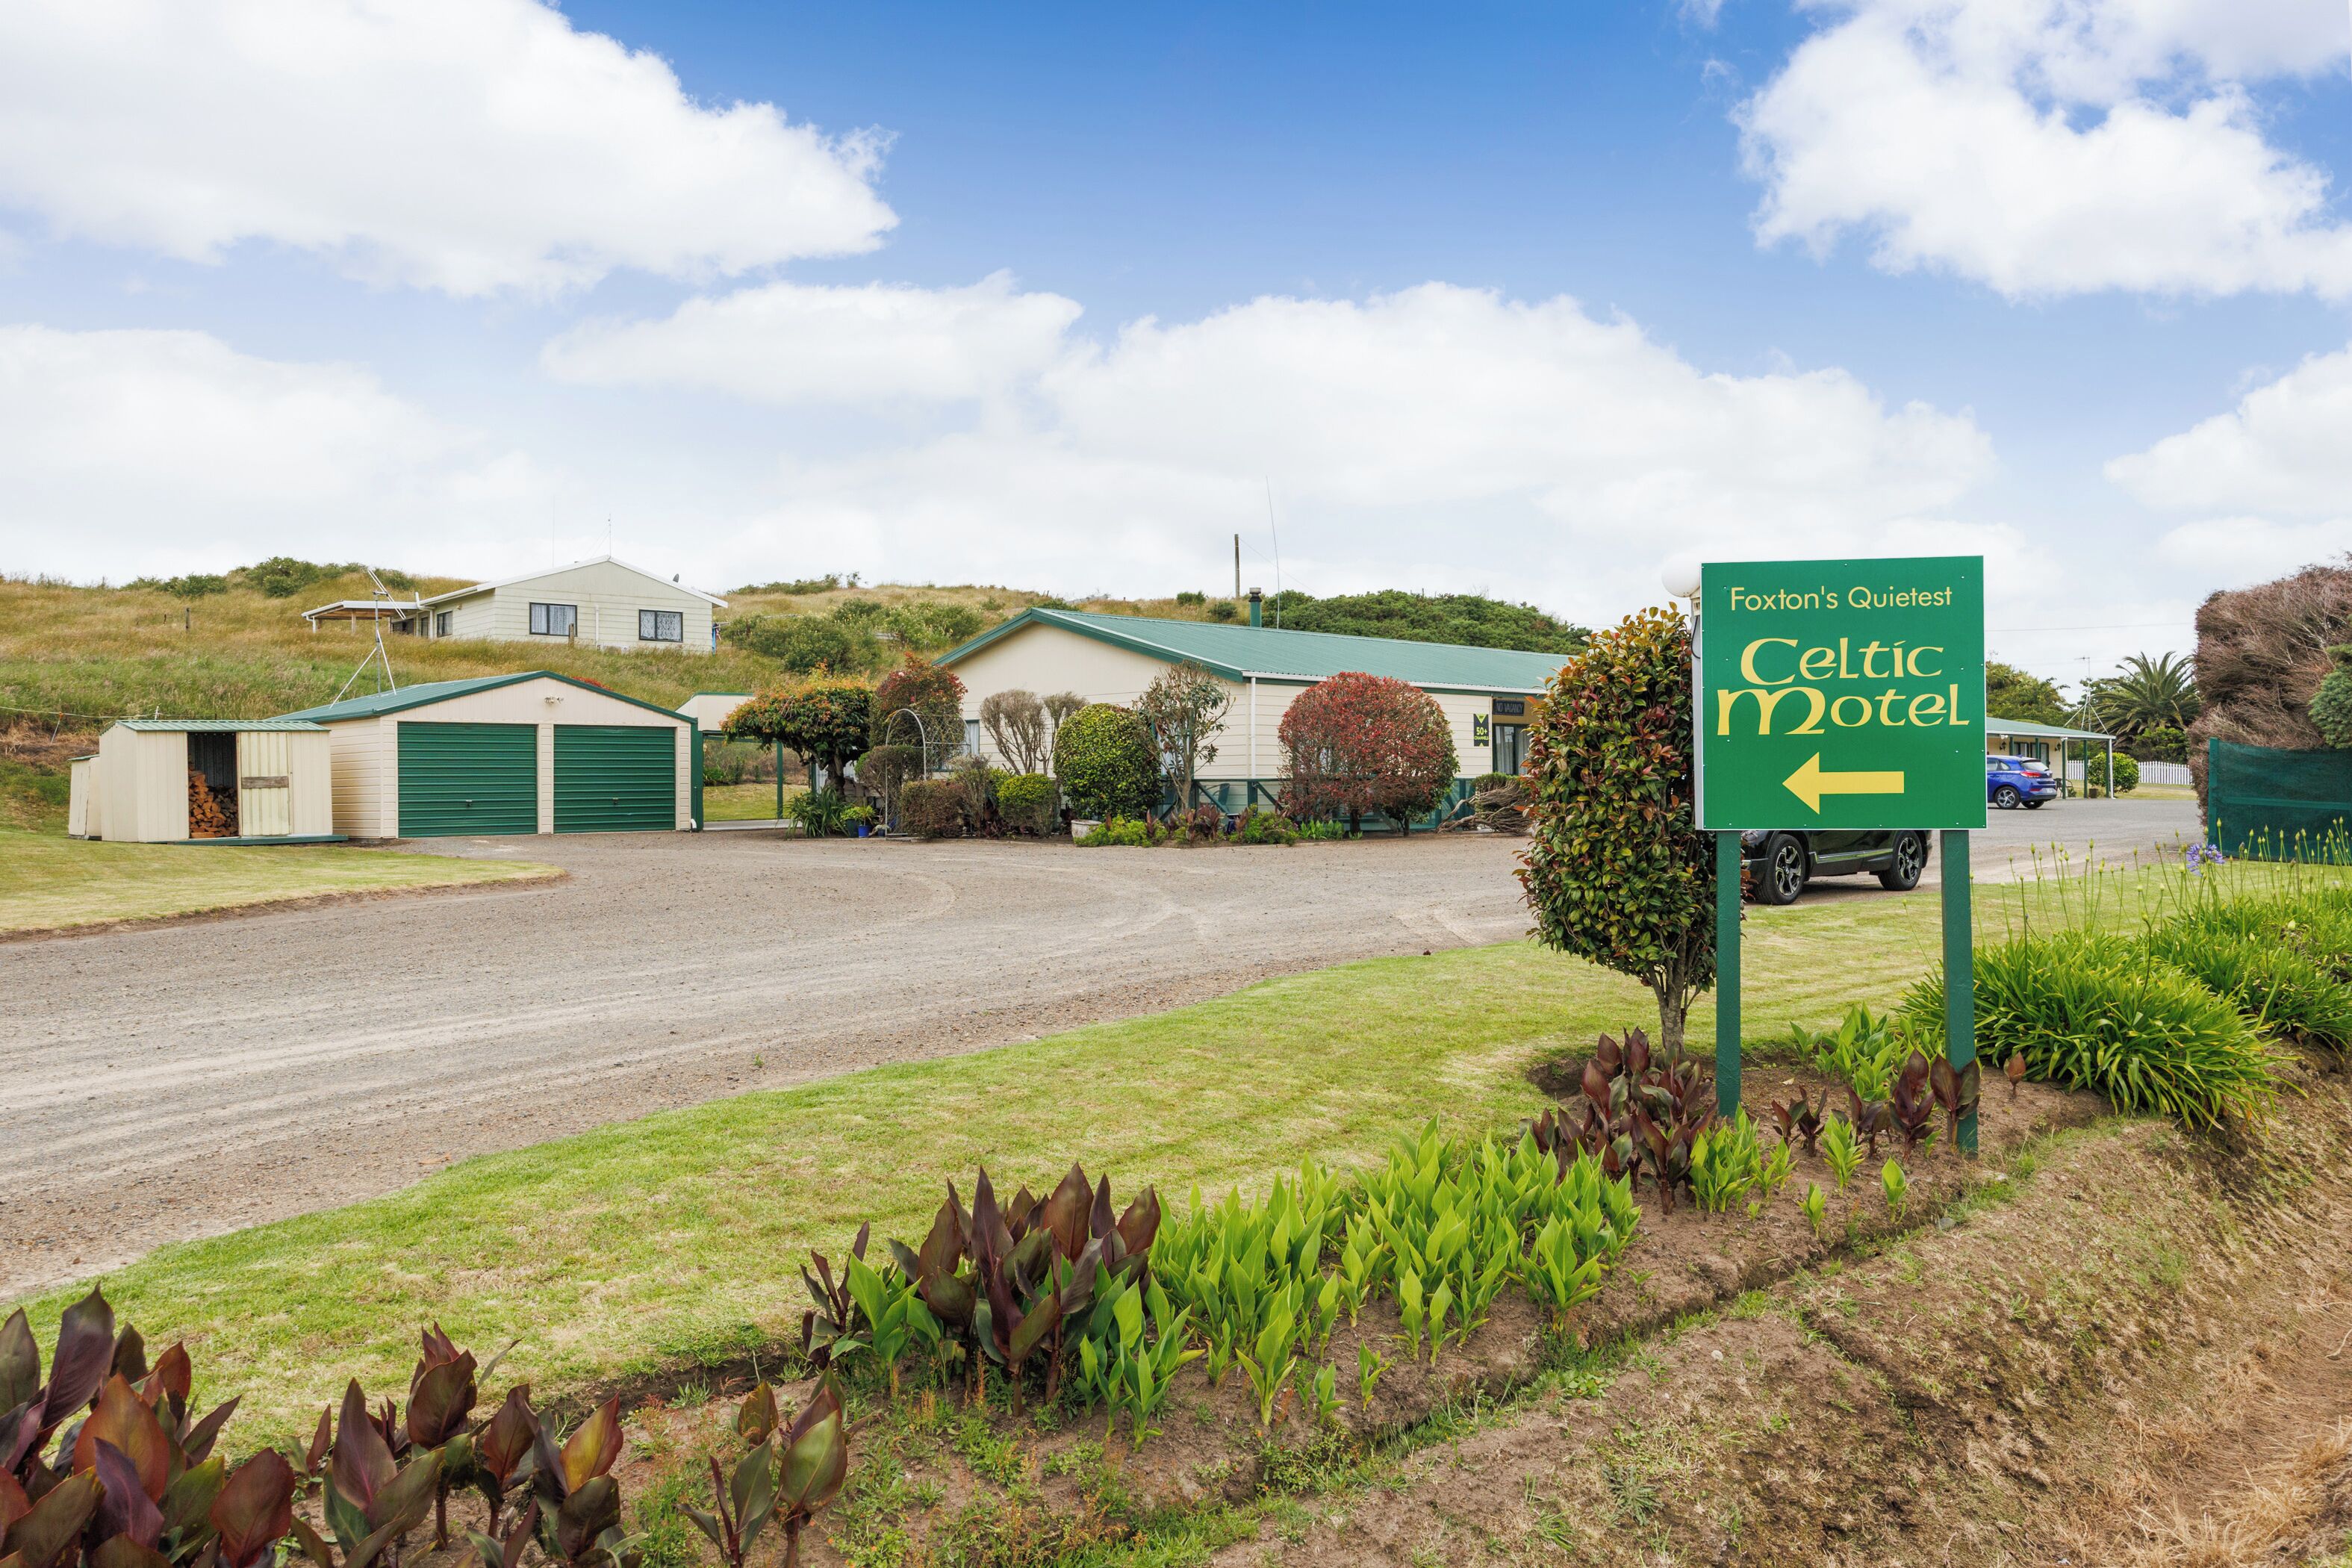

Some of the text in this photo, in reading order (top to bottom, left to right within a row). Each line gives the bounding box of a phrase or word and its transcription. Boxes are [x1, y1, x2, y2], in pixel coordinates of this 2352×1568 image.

[1731, 586, 1953, 611] Foxton's Quietest
[1740, 638, 1944, 685] Celtic
[1717, 684, 1970, 735] Motel
[1476, 727, 1488, 735] 50+
